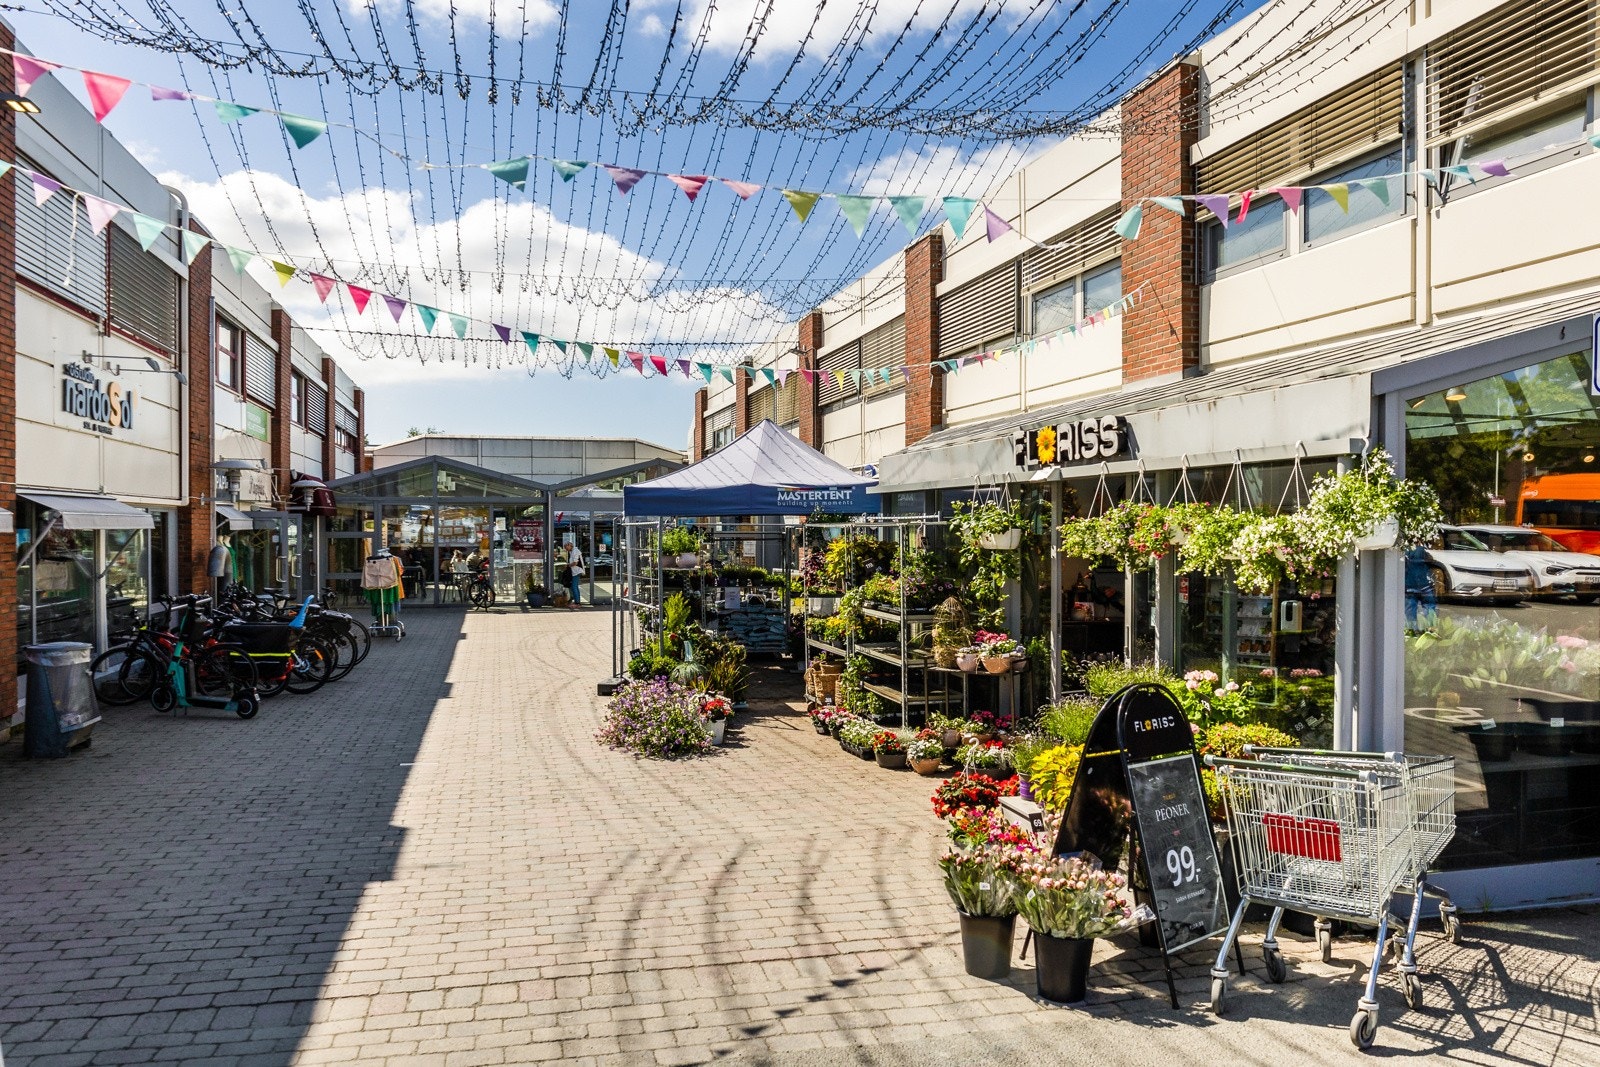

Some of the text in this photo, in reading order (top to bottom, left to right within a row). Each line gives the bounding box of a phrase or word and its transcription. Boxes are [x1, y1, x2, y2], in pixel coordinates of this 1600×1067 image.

[1012, 415, 1120, 466] FLORISS
[777, 490, 852, 501] MASTERTENT
[777, 499, 808, 507] building
[1155, 803, 1190, 822] PEONER
